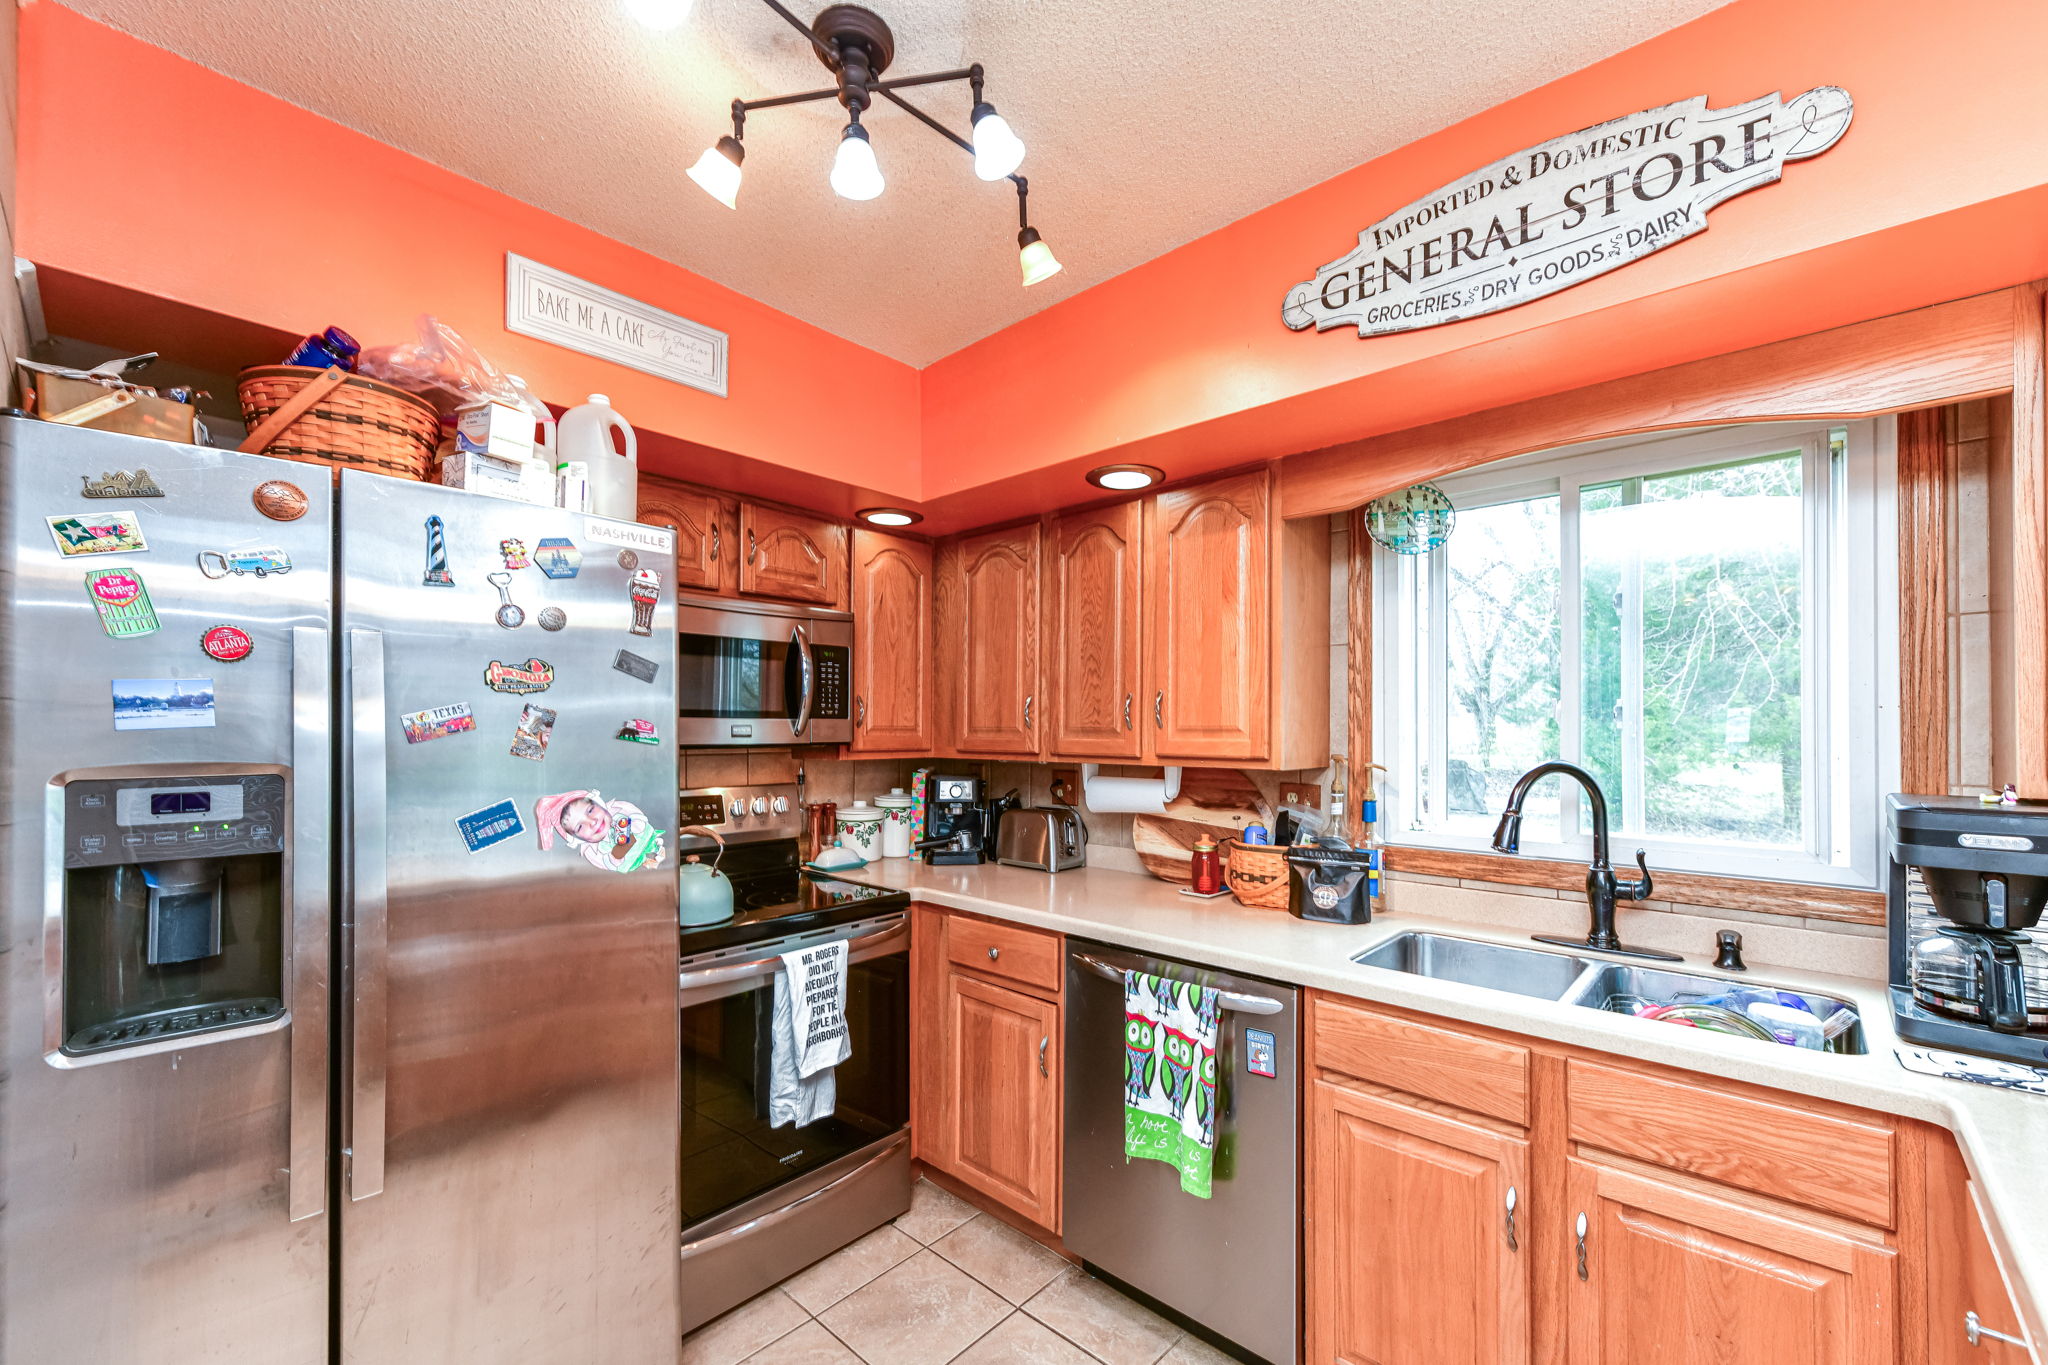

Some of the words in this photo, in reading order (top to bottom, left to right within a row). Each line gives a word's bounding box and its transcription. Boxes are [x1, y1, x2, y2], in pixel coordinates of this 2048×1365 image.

[1373, 178, 1494, 251] IMPORTED
[1500, 165, 1523, 190] &
[1528, 116, 1687, 180] DOMESTIC
[1320, 202, 1545, 310] GENERAL
[1562, 113, 1775, 231] STORE
[1367, 290, 1462, 324] GROCERIES
[1481, 273, 1521, 301] DRY
[1528, 243, 1606, 286] GOODS
[1626, 202, 1693, 248] DAIRY
[537, 287, 569, 323] BAKE
[578, 302, 593, 331] ME
[601, 311, 611, 337] A
[616, 315, 645, 348] CAKE
[83, 487, 165, 496] Guatemala
[591, 525, 665, 548] NASHVILLE
[107, 577, 120, 585] Dr
[98, 585, 135, 596] Pepper
[208, 637, 248, 652] ATLANTA
[432, 704, 465, 720] TEXAS
[801, 953, 815, 966] MR.
[815, 945, 839, 961] ROGERS
[808, 964, 821, 977] DID
[821, 960, 834, 973] NOT
[812, 1004, 825, 1017] FOR
[1140, 1115, 1168, 1133] hoot
[1126, 1125, 1147, 1152] life
[1154, 1136, 1168, 1149] is
